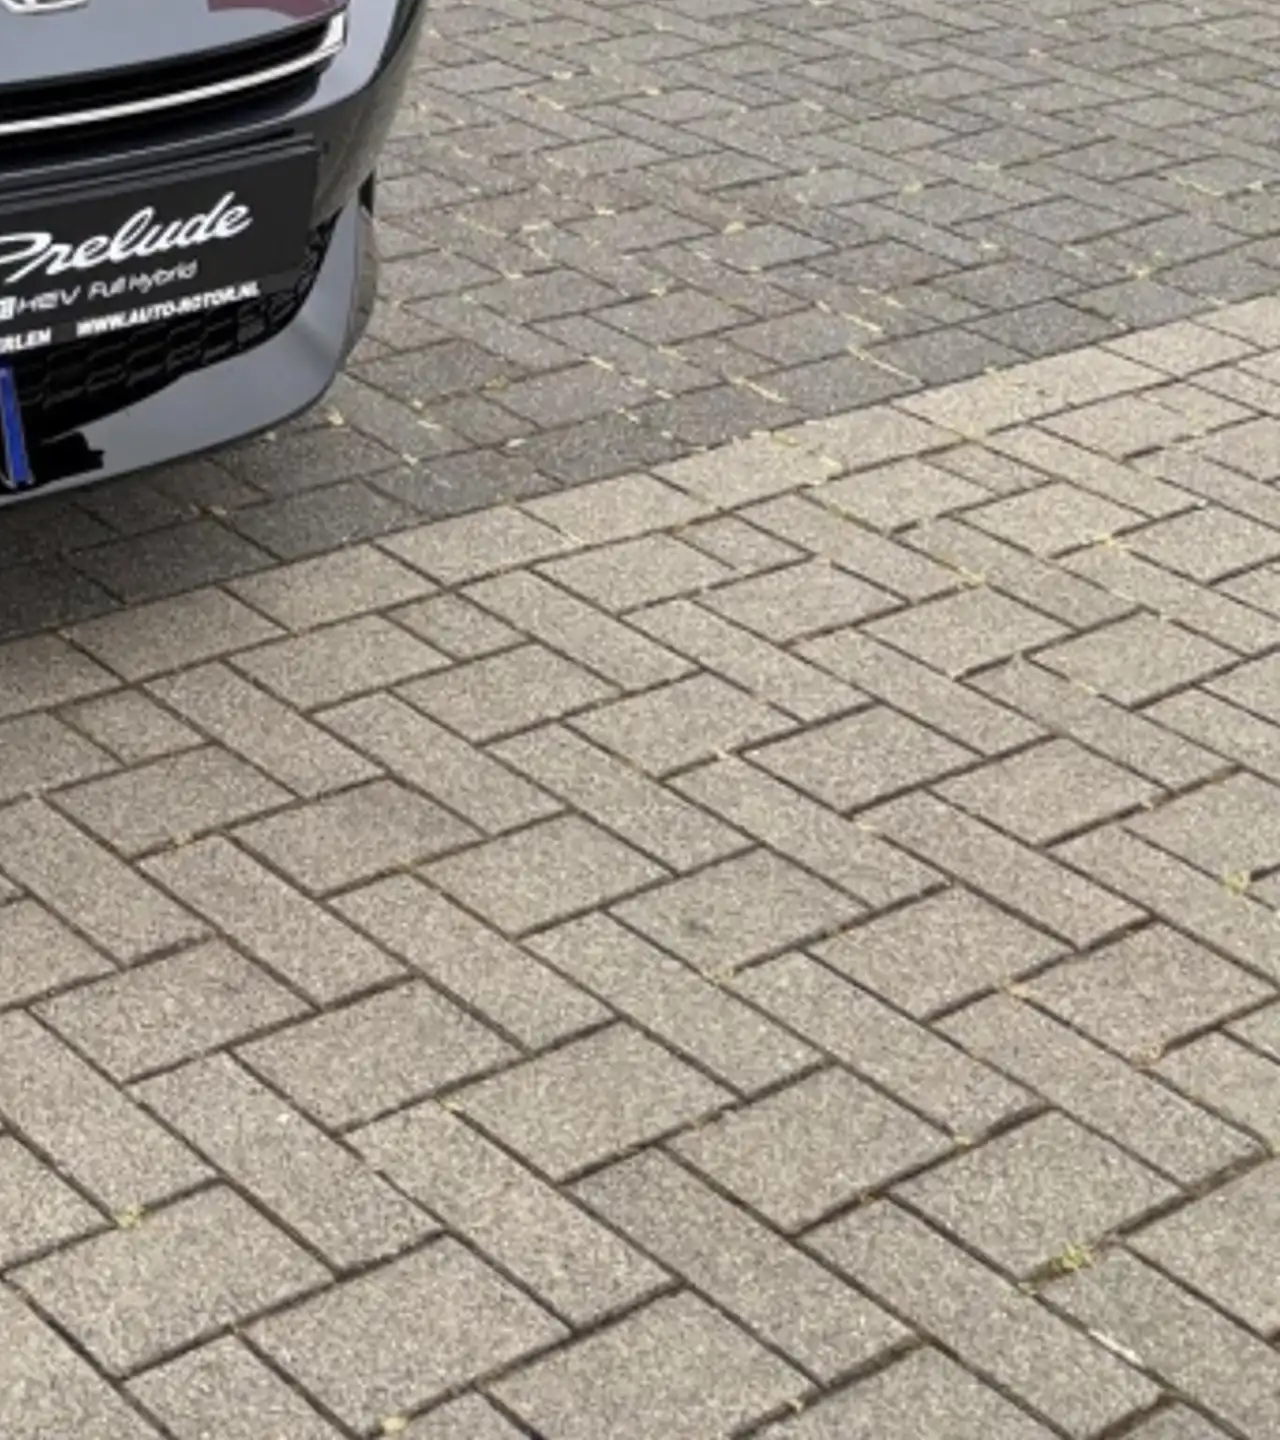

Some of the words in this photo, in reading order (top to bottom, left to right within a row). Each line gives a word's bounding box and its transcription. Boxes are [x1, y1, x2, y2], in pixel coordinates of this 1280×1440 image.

[88, 274, 127, 301] Full
[128, 258, 199, 294] Hybrid
[75, 279, 261, 338] WWW.AUTO-ROTOR.NL
